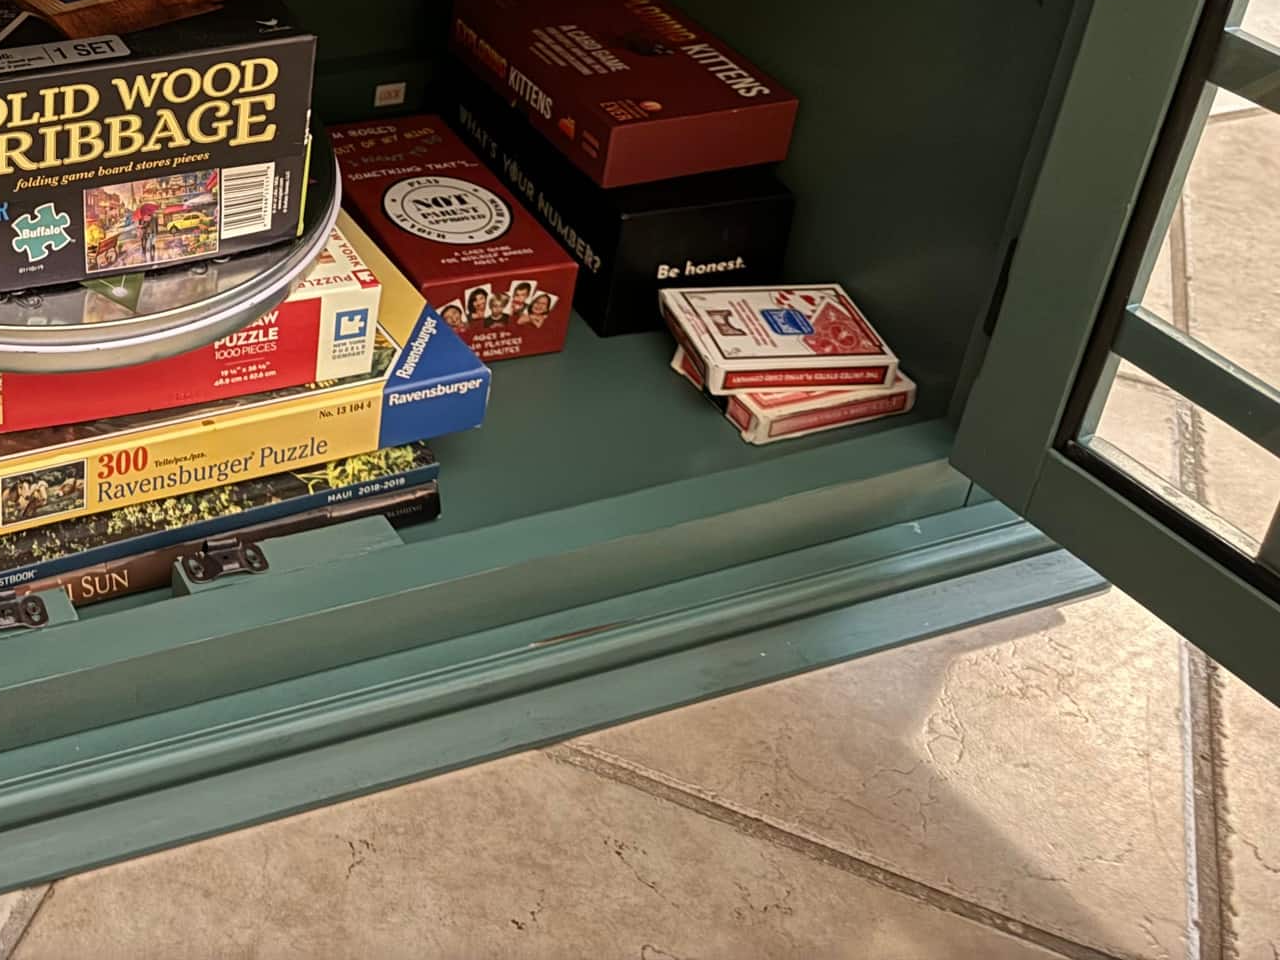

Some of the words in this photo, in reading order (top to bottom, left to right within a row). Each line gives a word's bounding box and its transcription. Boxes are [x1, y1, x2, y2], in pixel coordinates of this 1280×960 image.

[55, 42, 65, 60] 1
[74, 39, 117, 57] SET
[681, 41, 771, 99] KITTENS
[111, 56, 280, 113] WOOD
[506, 64, 554, 121] KITTENS
[14, 174, 59, 194] folding
[61, 172, 94, 189] game
[97, 163, 132, 179] board
[136, 159, 170, 173] stores
[173, 152, 211, 170] pieces
[347, 164, 422, 182] SOMETHING
[407, 178, 441, 187] PLAY
[412, 194, 470, 211] NOT
[421, 207, 479, 220] PARENT
[427, 214, 487, 226] APPROVED
[22, 224, 63, 241] Buffalo
[537, 191, 602, 275] NUMBER?
[338, 242, 363, 268] YORK
[656, 265, 680, 280] Be
[685, 257, 746, 277] honest.
[213, 327, 280, 350] PUZZLE
[397, 316, 438, 381] Ravensburger
[214, 347, 241, 361] 1000
[241, 341, 278, 357] PIECES
[389, 378, 484, 408] Ravensburger
[96, 452, 252, 504] Ravensburger
[259, 438, 329, 469] Puzzle
[97, 446, 149, 480] 300
[327, 489, 354, 504] MAUI
[81, 569, 130, 599] SUN
